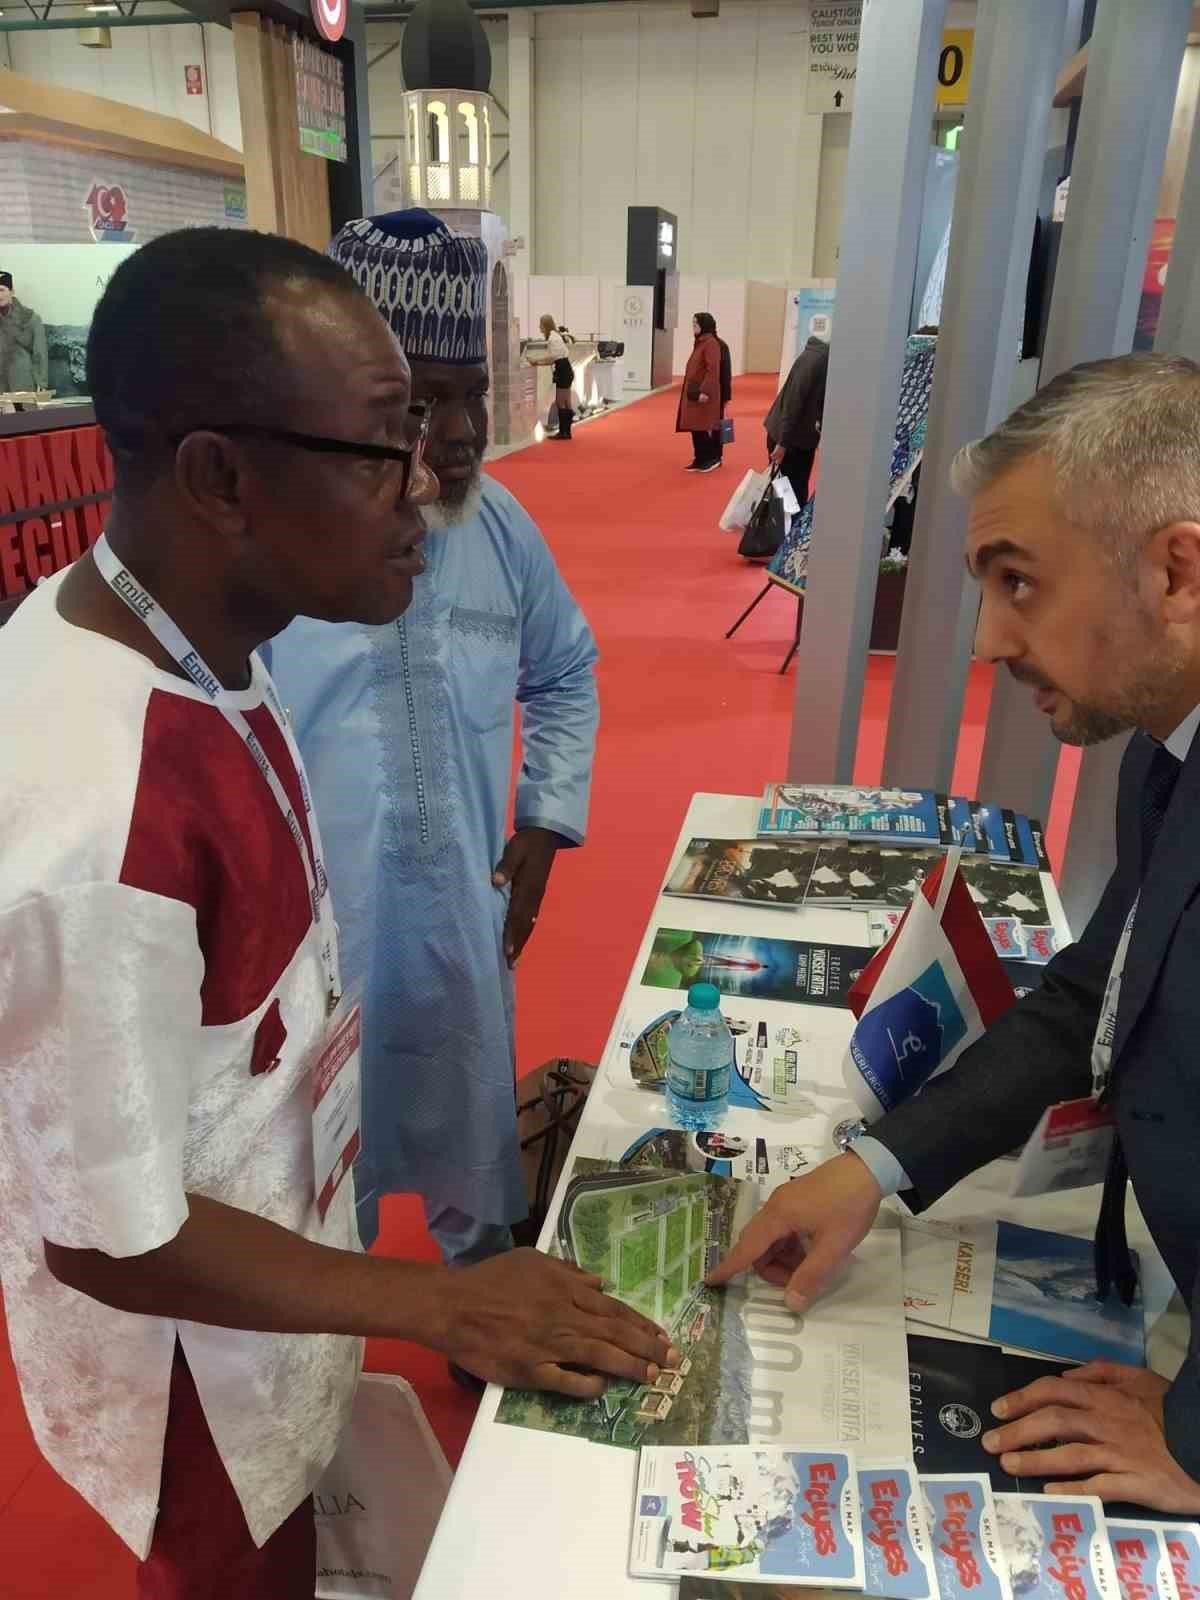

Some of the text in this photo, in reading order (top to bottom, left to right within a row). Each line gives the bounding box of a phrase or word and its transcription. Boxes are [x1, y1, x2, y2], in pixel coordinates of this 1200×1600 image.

[811, 44, 834, 54] YOU
[181, 650, 222, 699] Emitt
[953, 1241, 976, 1296] KAYSERİ
[909, 1372, 925, 1455] ERCİYES
[801, 1462, 838, 1557] Erciyes
[845, 1511, 854, 1535] MAP
[866, 1478, 909, 1577] Erciyes
[909, 1504, 924, 1552] SKI MAP
[938, 1491, 984, 1590] Erciyes
[982, 1517, 998, 1564] SKI MAP
[1093, 1543, 1108, 1593] SKI MAP
